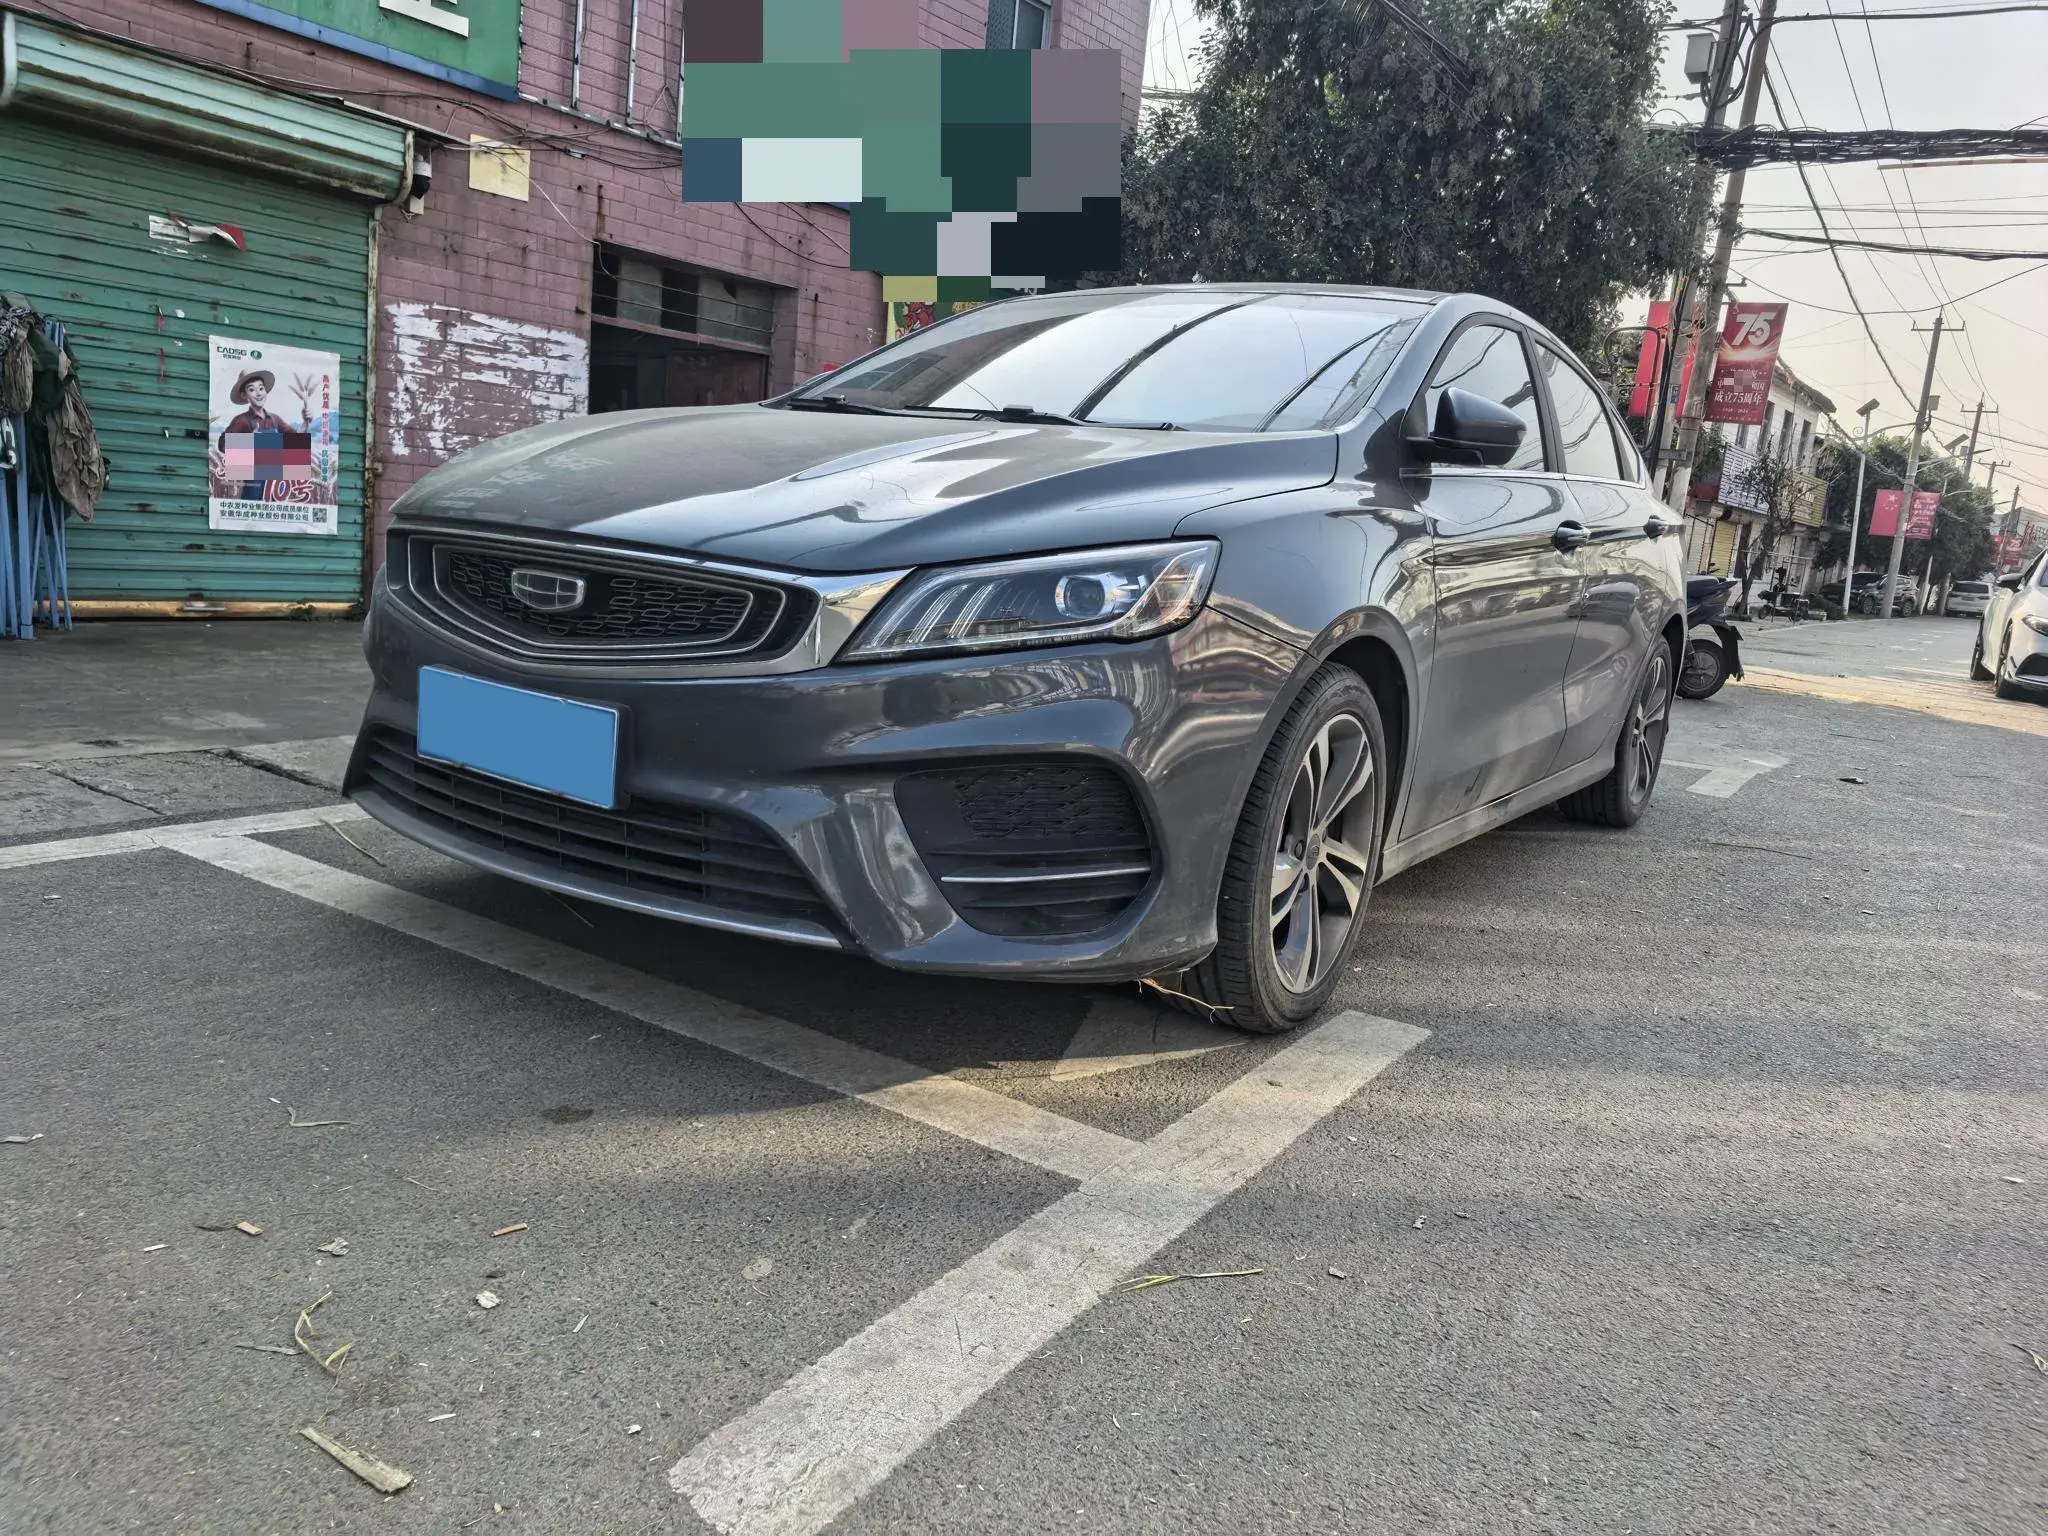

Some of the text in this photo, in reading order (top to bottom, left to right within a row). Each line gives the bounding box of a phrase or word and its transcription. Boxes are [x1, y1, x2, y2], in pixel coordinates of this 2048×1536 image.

[1731, 312, 1777, 346] 75
[216, 346, 247, 356] CADSG
[1714, 391, 1763, 405] 成立75周年
